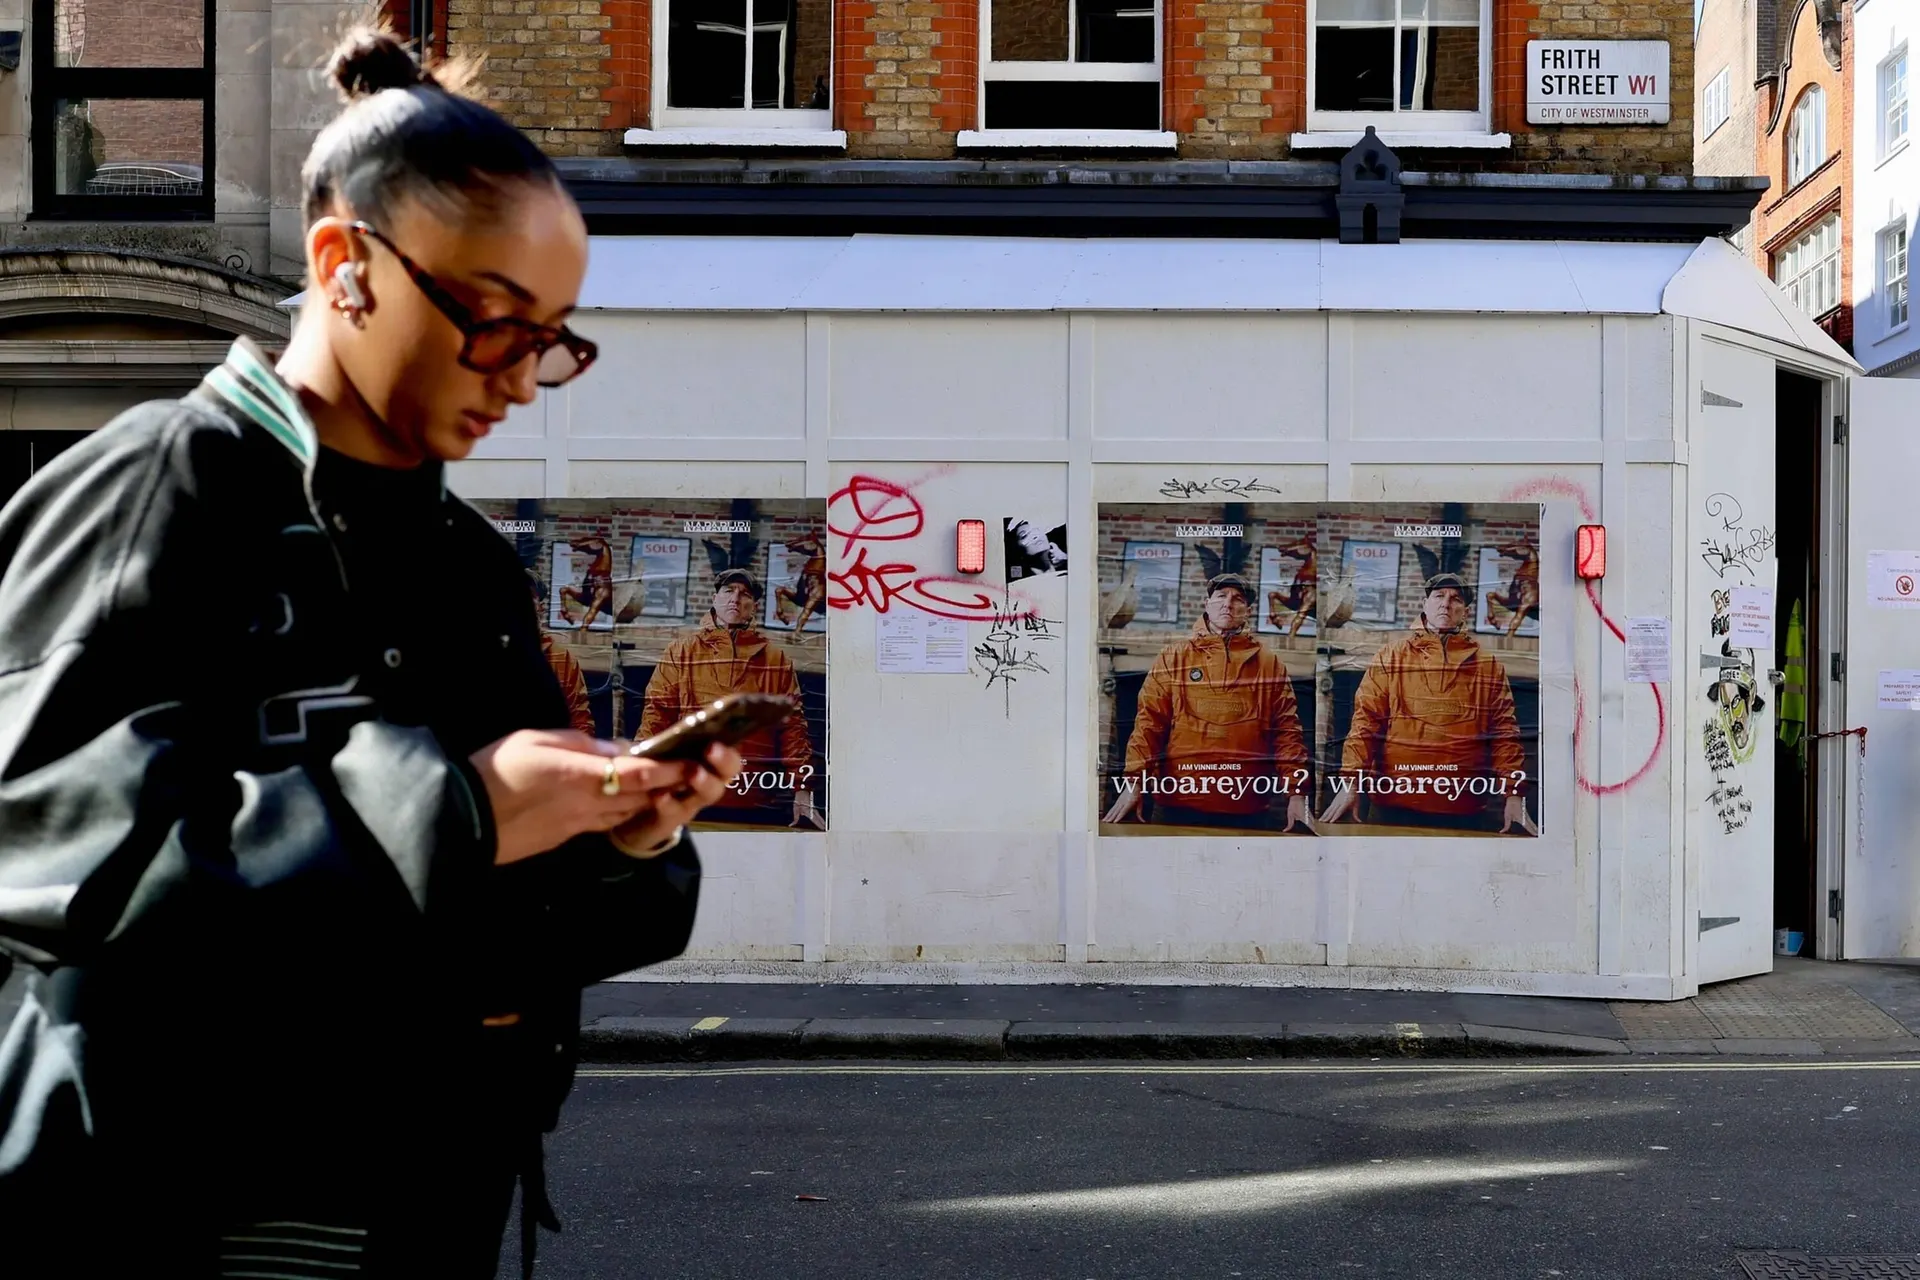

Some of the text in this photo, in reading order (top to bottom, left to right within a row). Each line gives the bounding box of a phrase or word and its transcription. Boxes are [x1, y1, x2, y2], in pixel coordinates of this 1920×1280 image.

[1541, 49, 1600, 69] FRITH
[1541, 75, 1656, 95] STREET W1
[1541, 108, 1649, 118] CITY OF WESTMINSTER
[645, 543, 678, 554] SOLD
[1137, 549, 1170, 558] SOLD
[1355, 548, 1388, 558] SOLD
[1111, 769, 1309, 800] whoareyou?
[1327, 769, 1526, 801] whoareyou?
